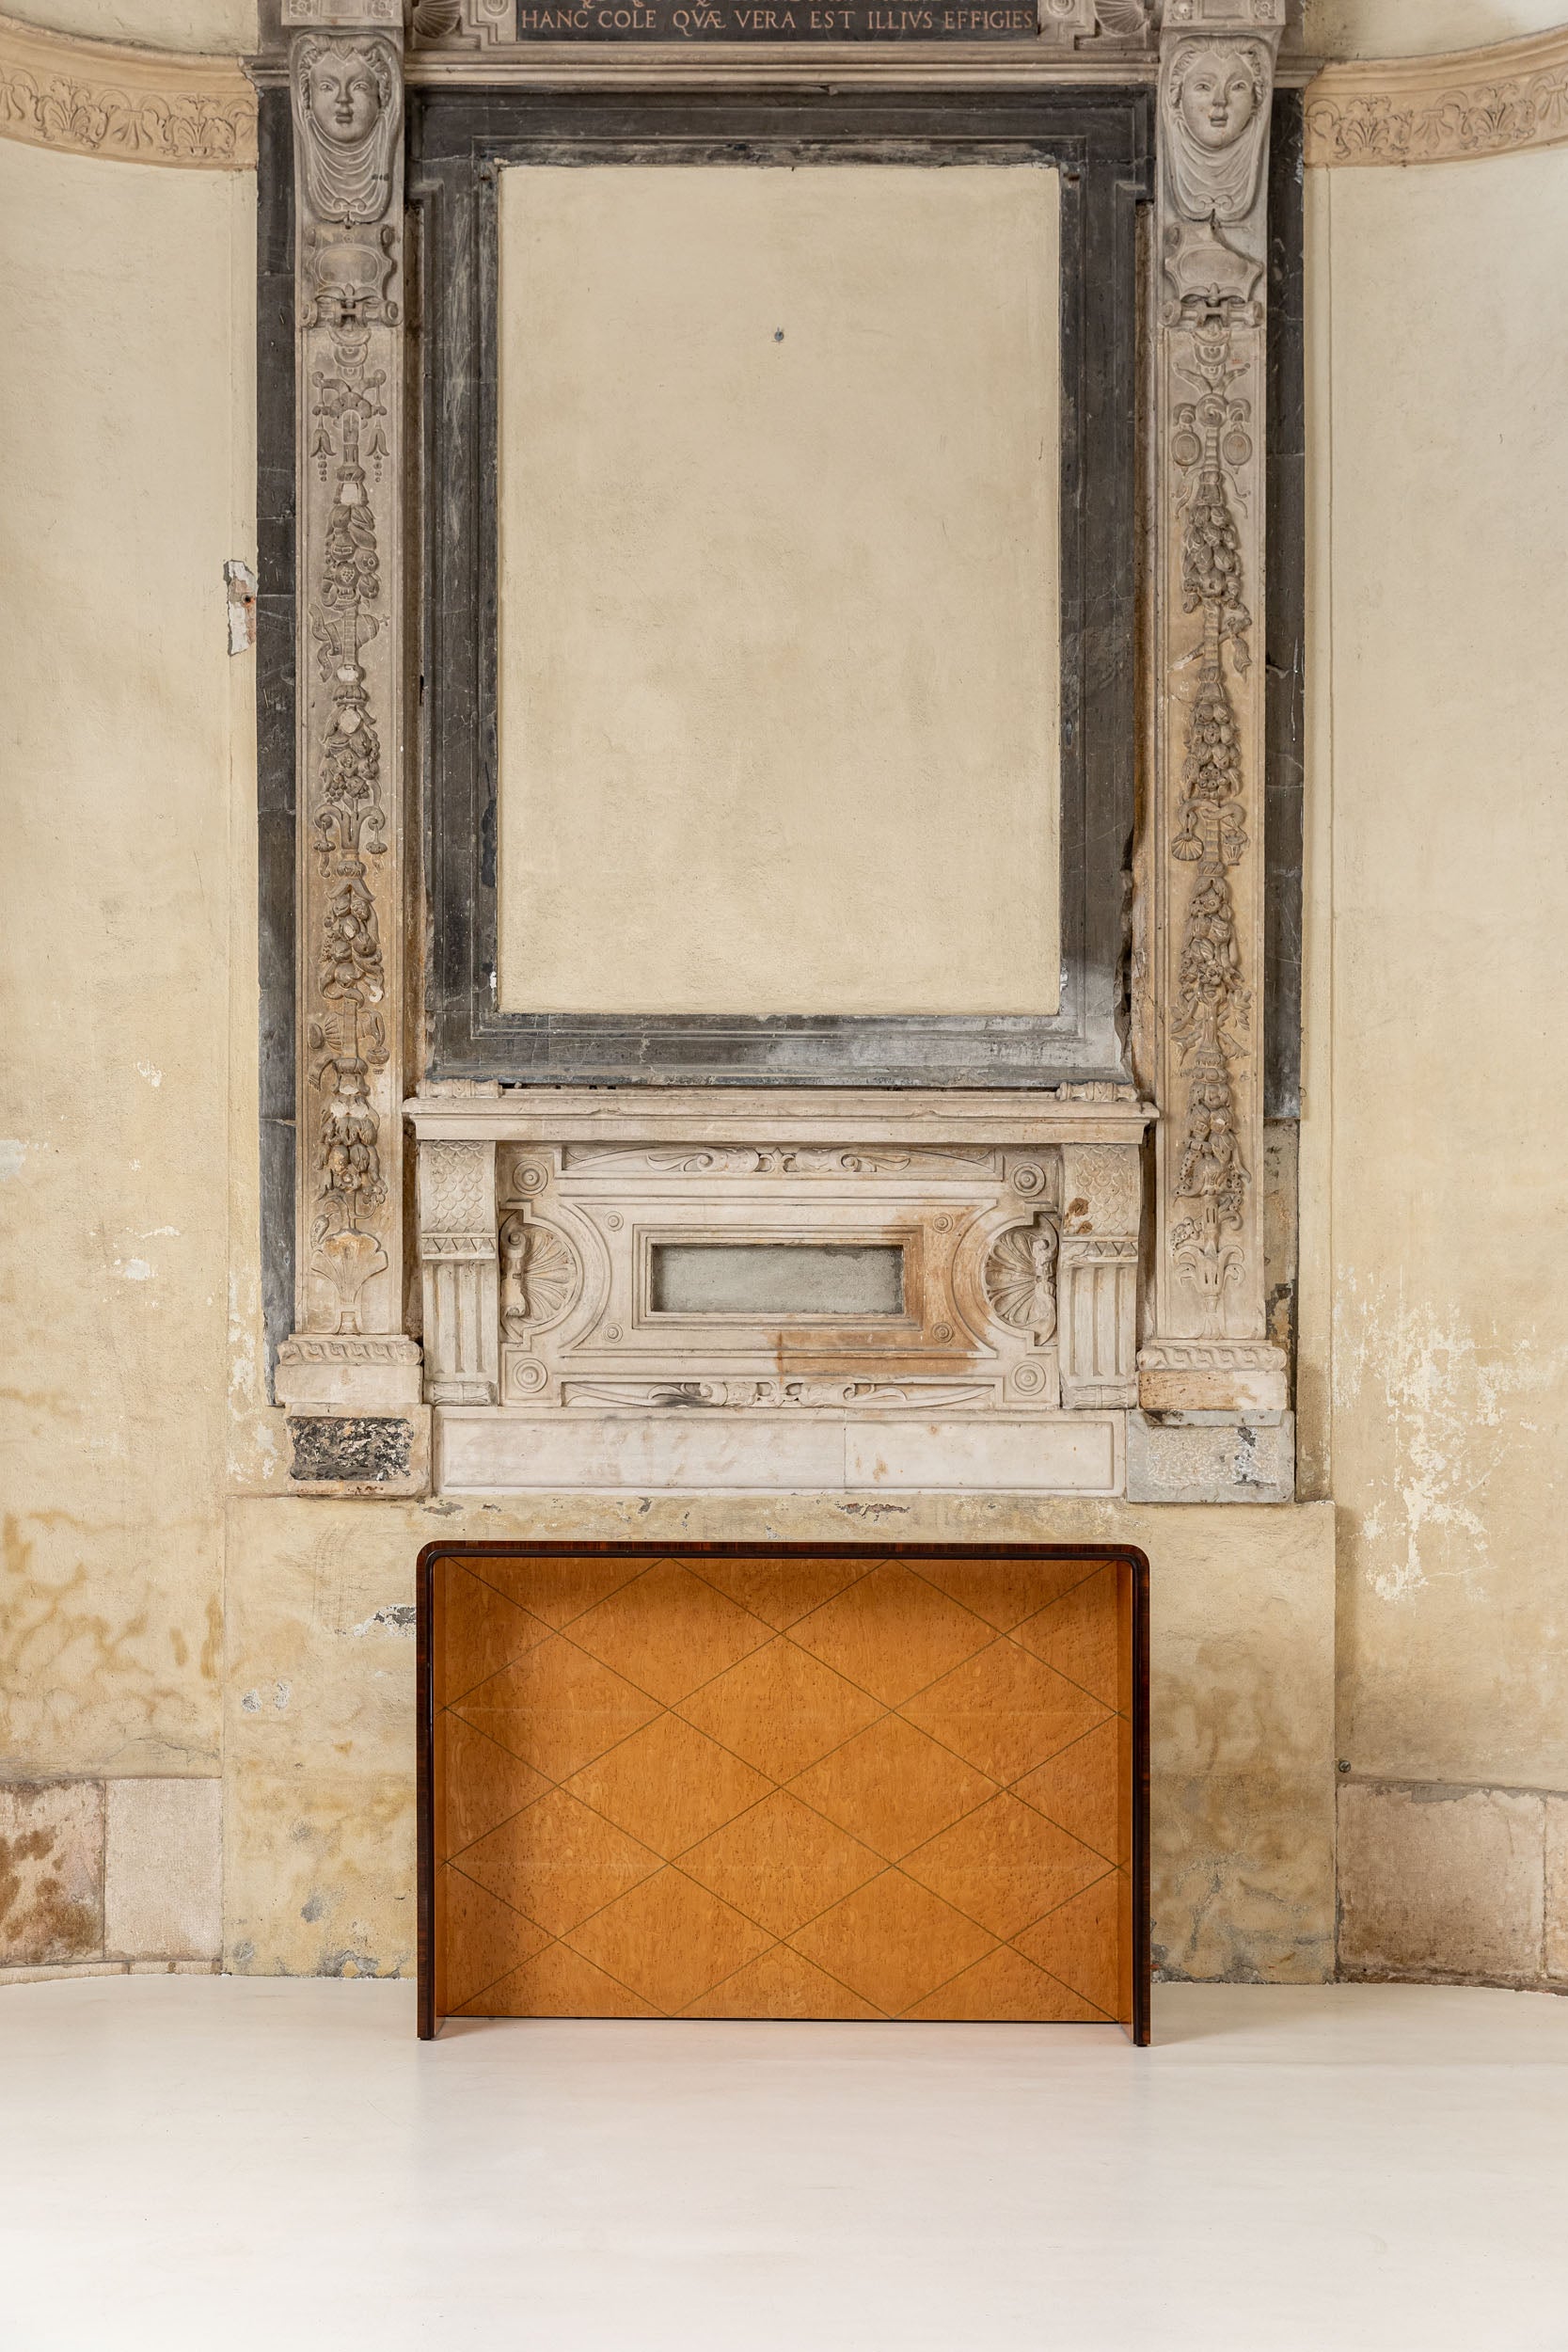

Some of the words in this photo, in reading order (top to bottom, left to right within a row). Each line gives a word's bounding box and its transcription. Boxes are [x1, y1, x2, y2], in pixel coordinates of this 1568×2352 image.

[521, 9, 589, 29] HANC
[597, 9, 657, 29] COLE
[673, 9, 727, 37] QVÆ
[734, 9, 797, 29] VERA
[811, 10, 856, 29] EST
[868, 10, 933, 30] ILLIVS
[944, 10, 1033, 30] EFFIGIES
